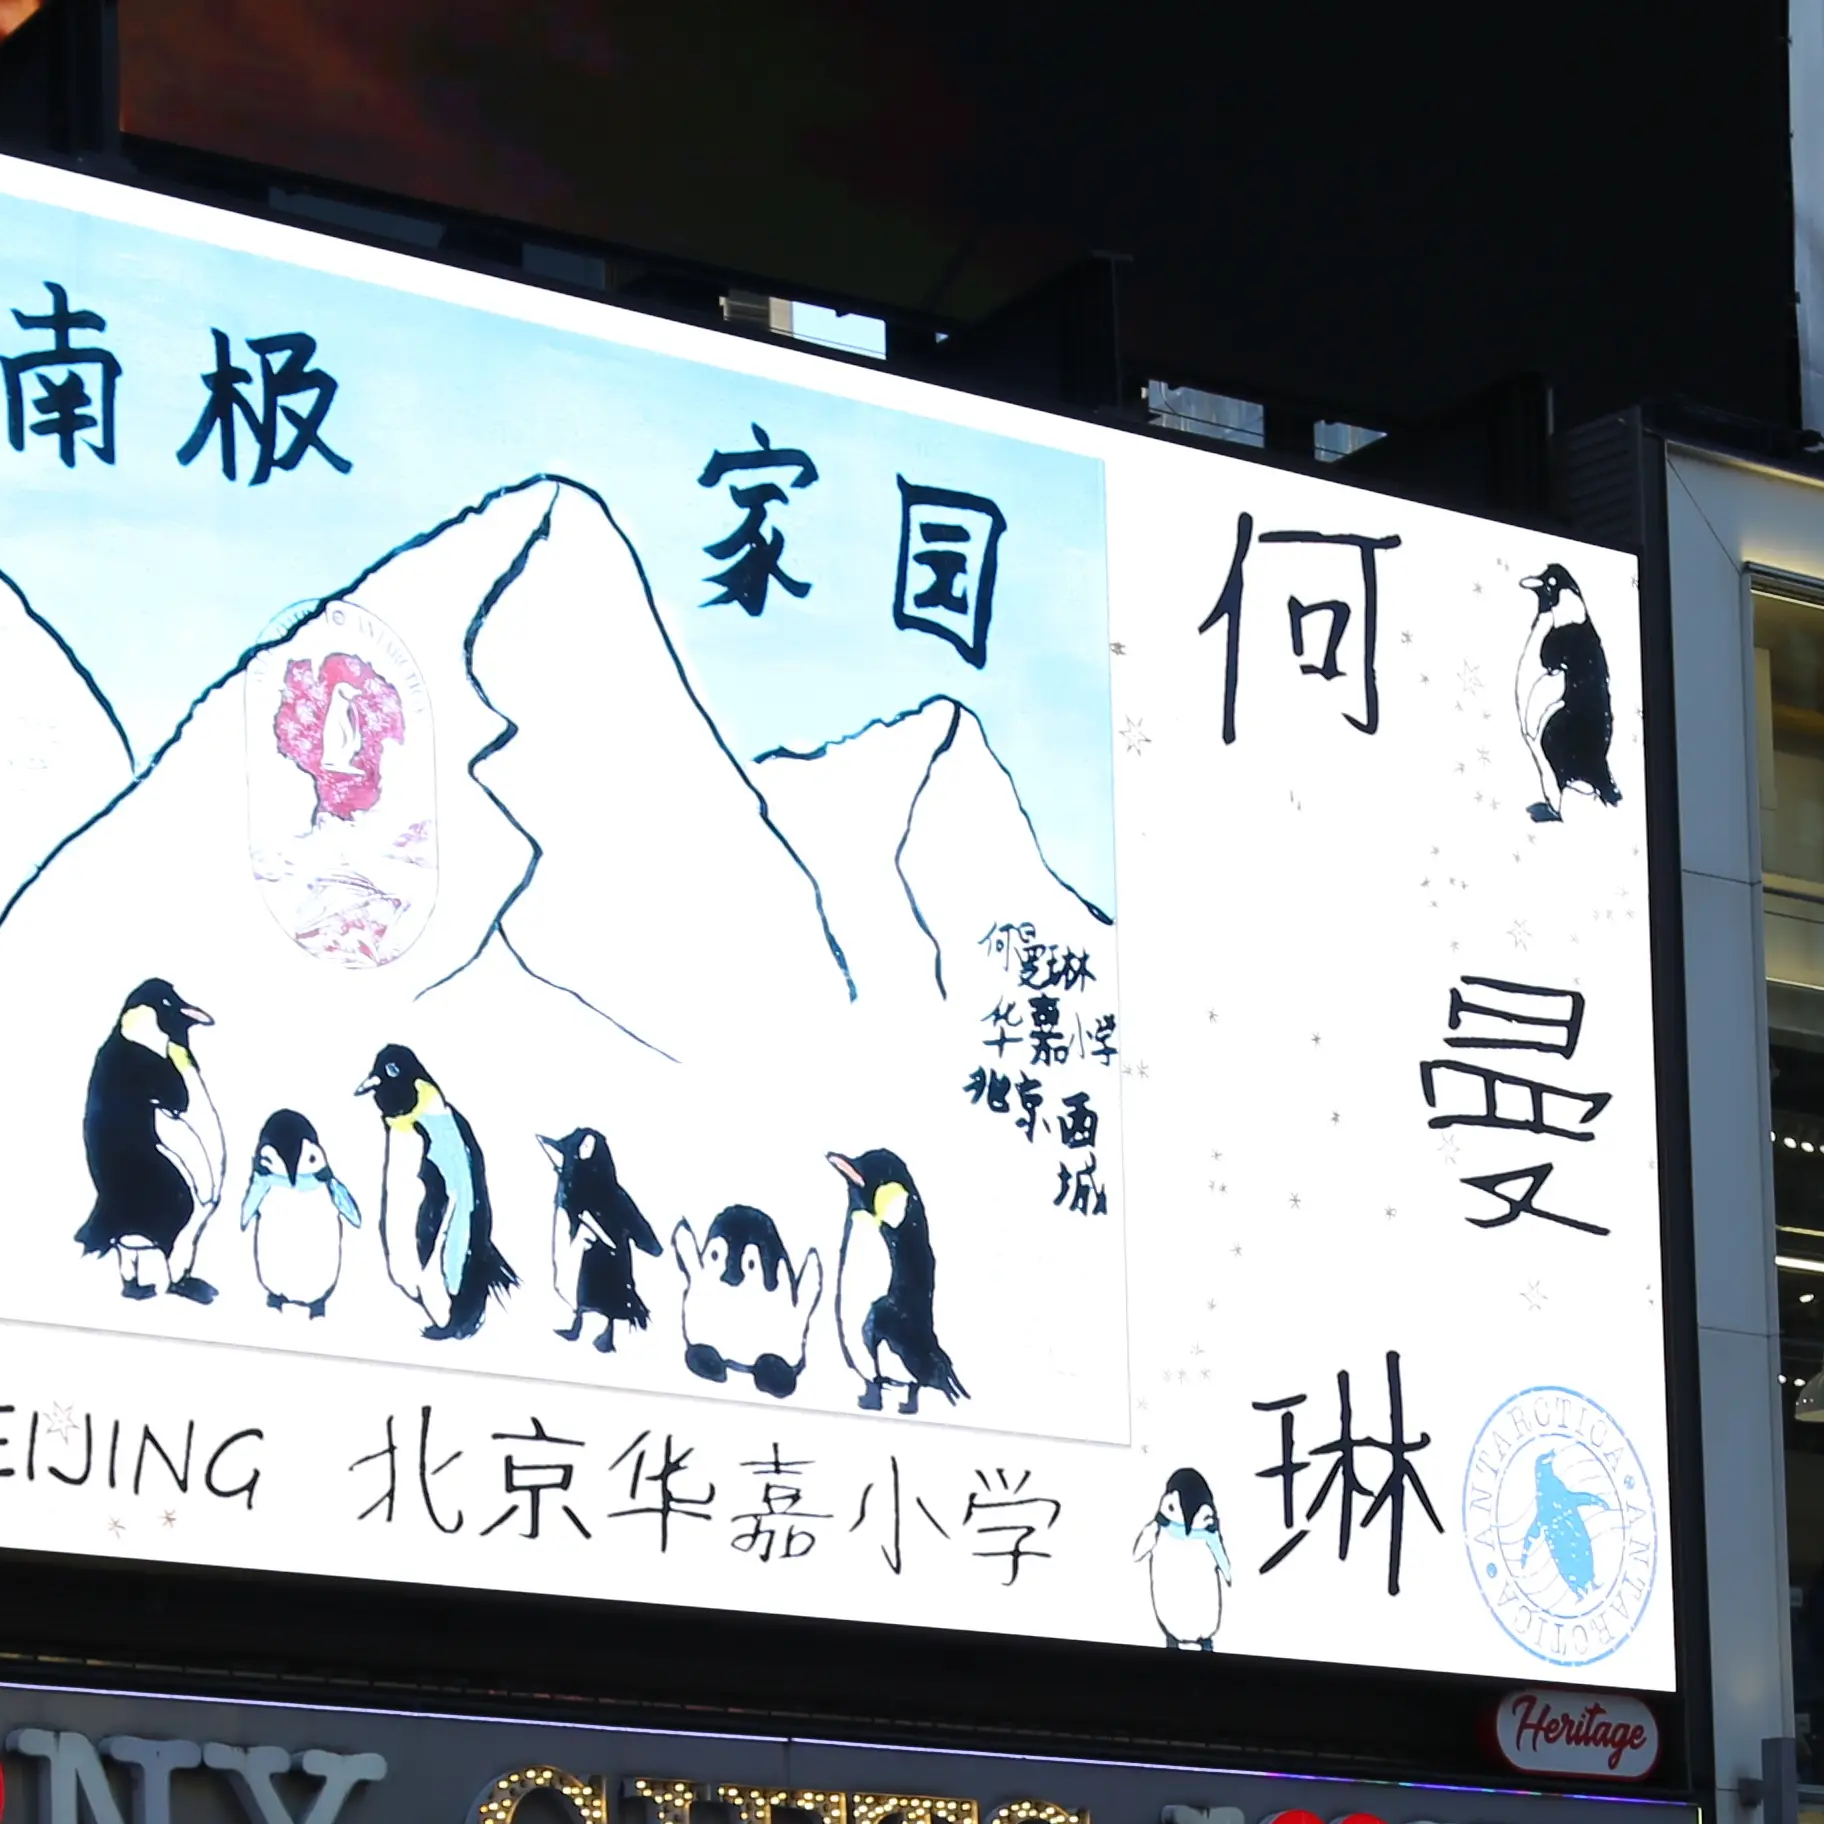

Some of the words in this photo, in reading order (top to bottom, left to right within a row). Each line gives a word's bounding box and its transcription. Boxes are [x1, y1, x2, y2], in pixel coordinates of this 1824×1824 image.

[698, 422, 1008, 670] 家园
[348, 1405, 1062, 1587] 北京华嘉小学
[1512, 1694, 1648, 1770] Heritage
